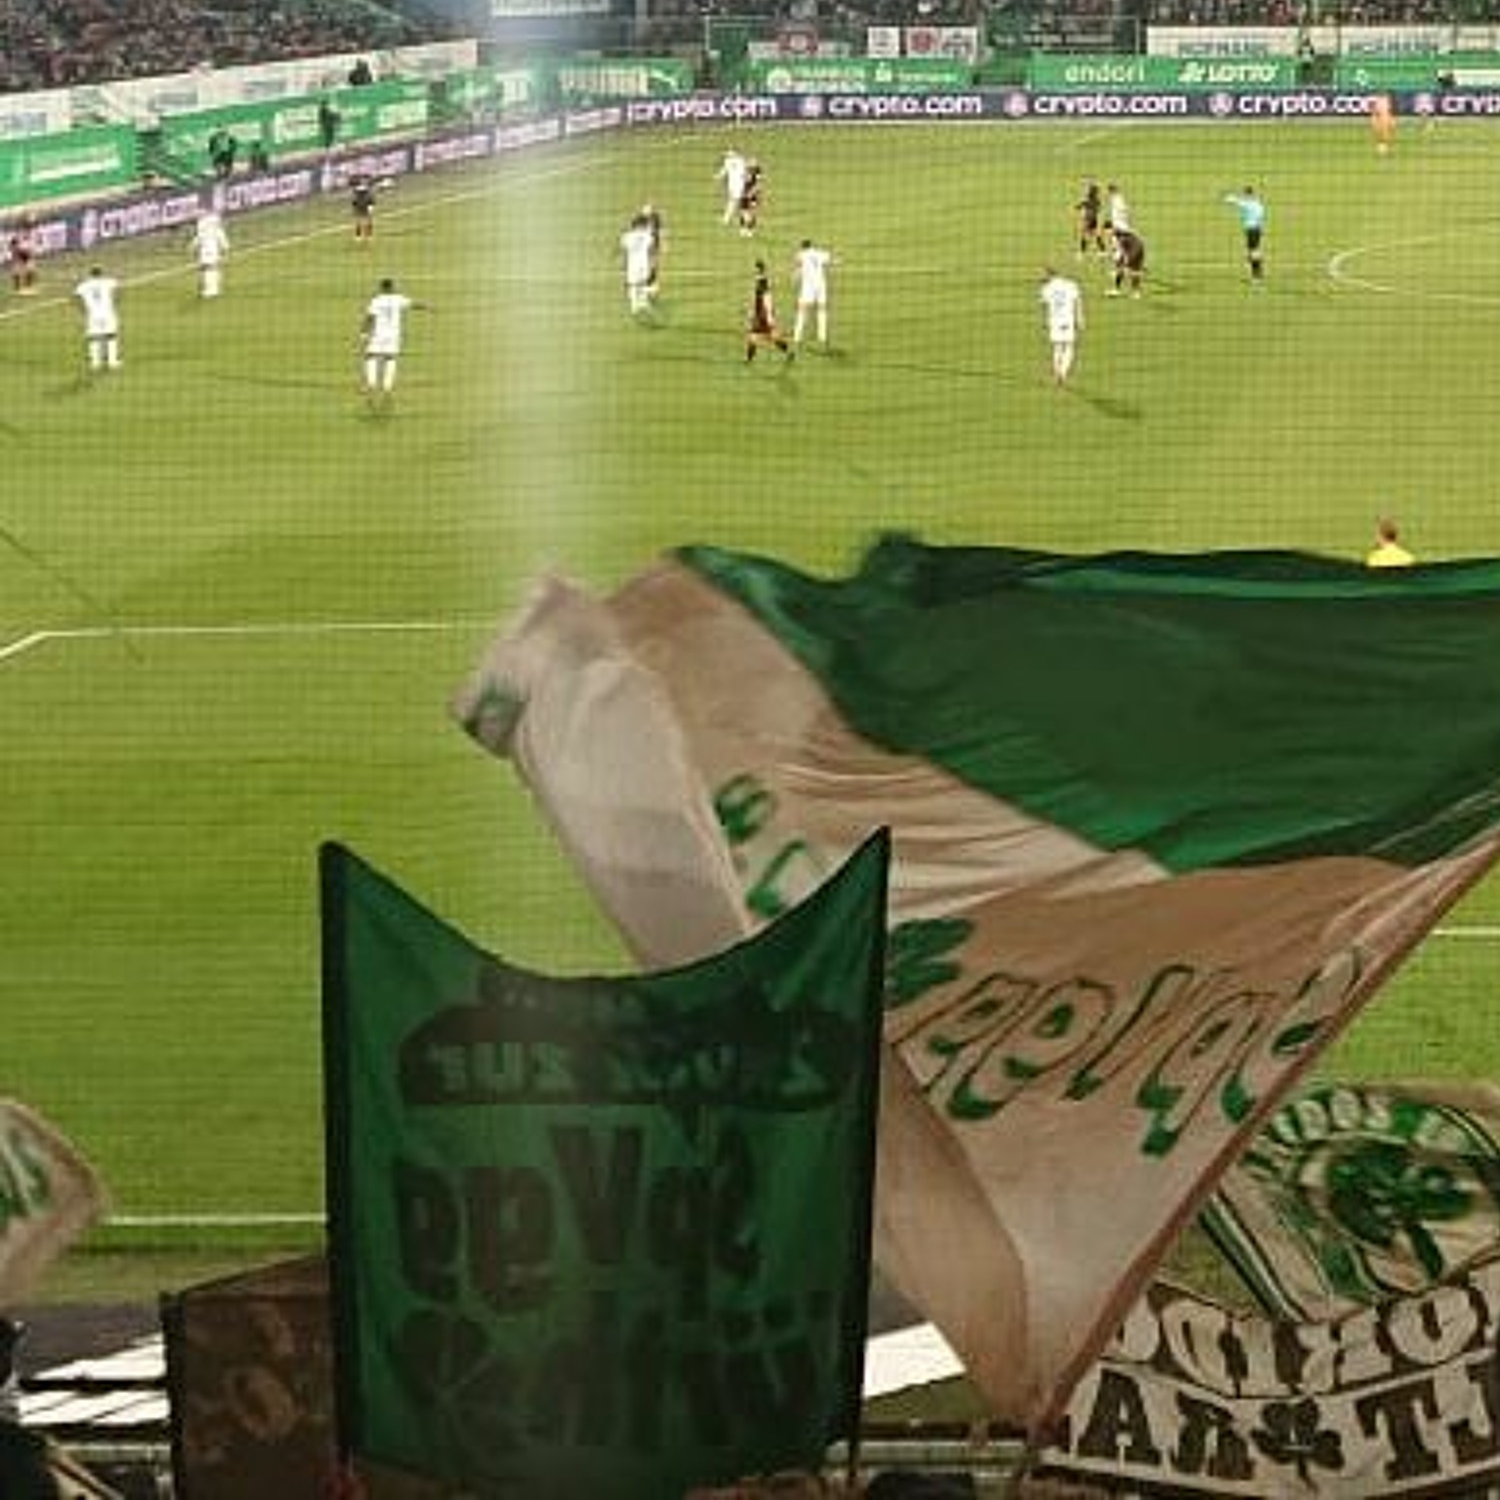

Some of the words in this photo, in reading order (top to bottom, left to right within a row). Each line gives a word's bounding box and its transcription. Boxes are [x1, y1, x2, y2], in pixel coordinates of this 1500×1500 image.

[1208, 63, 1278, 83] LOTTO
[829, 97, 982, 116] crypto.com
[1034, 95, 1187, 116] crypto.com
